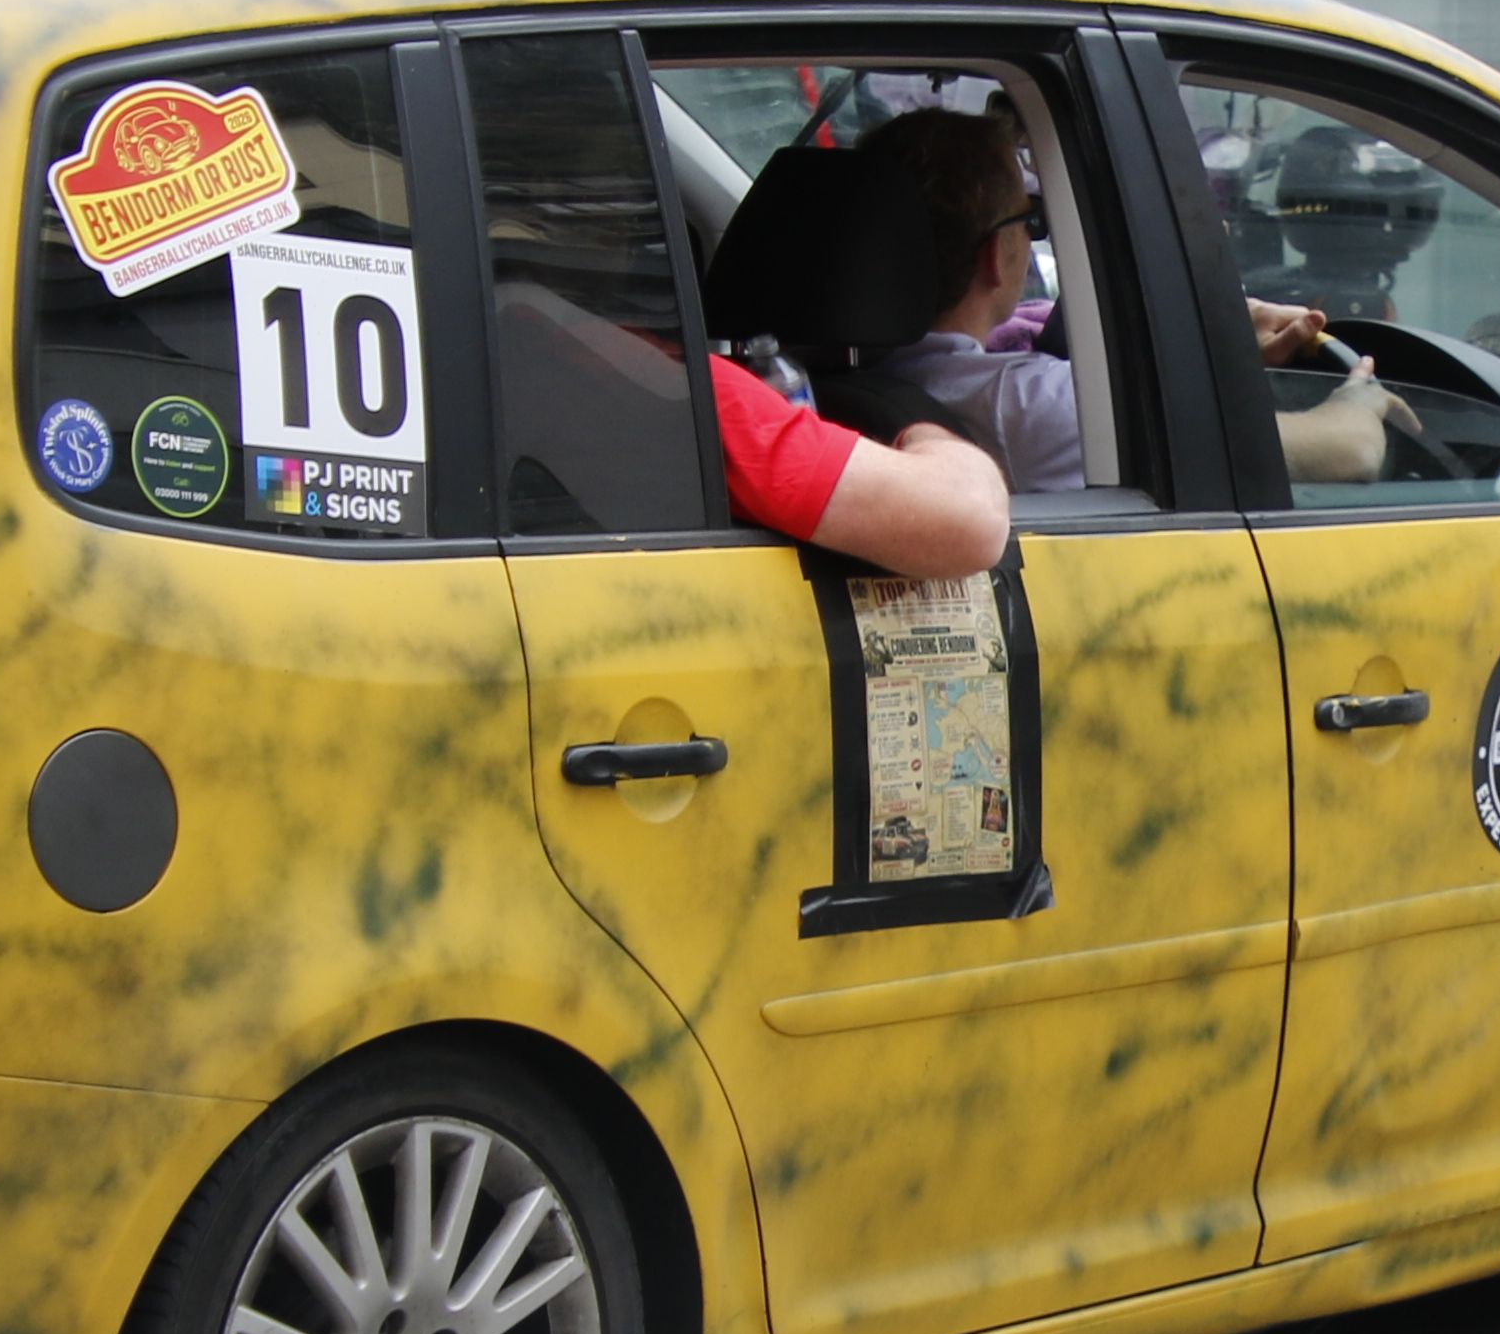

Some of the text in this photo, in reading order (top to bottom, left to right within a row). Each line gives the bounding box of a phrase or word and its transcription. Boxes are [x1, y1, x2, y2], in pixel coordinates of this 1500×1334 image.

[78, 133, 277, 247] BENIDORM OR BUST
[111, 200, 293, 289] BANGERRALLYCHALLENGE.CO.UK
[262, 285, 409, 439] 10
[148, 431, 182, 452] FCN
[302, 459, 415, 495] PJ PRINT
[181, 489, 193, 501] 111
[304, 490, 402, 524] & SIGNS
[874, 578, 907, 604] TOP
